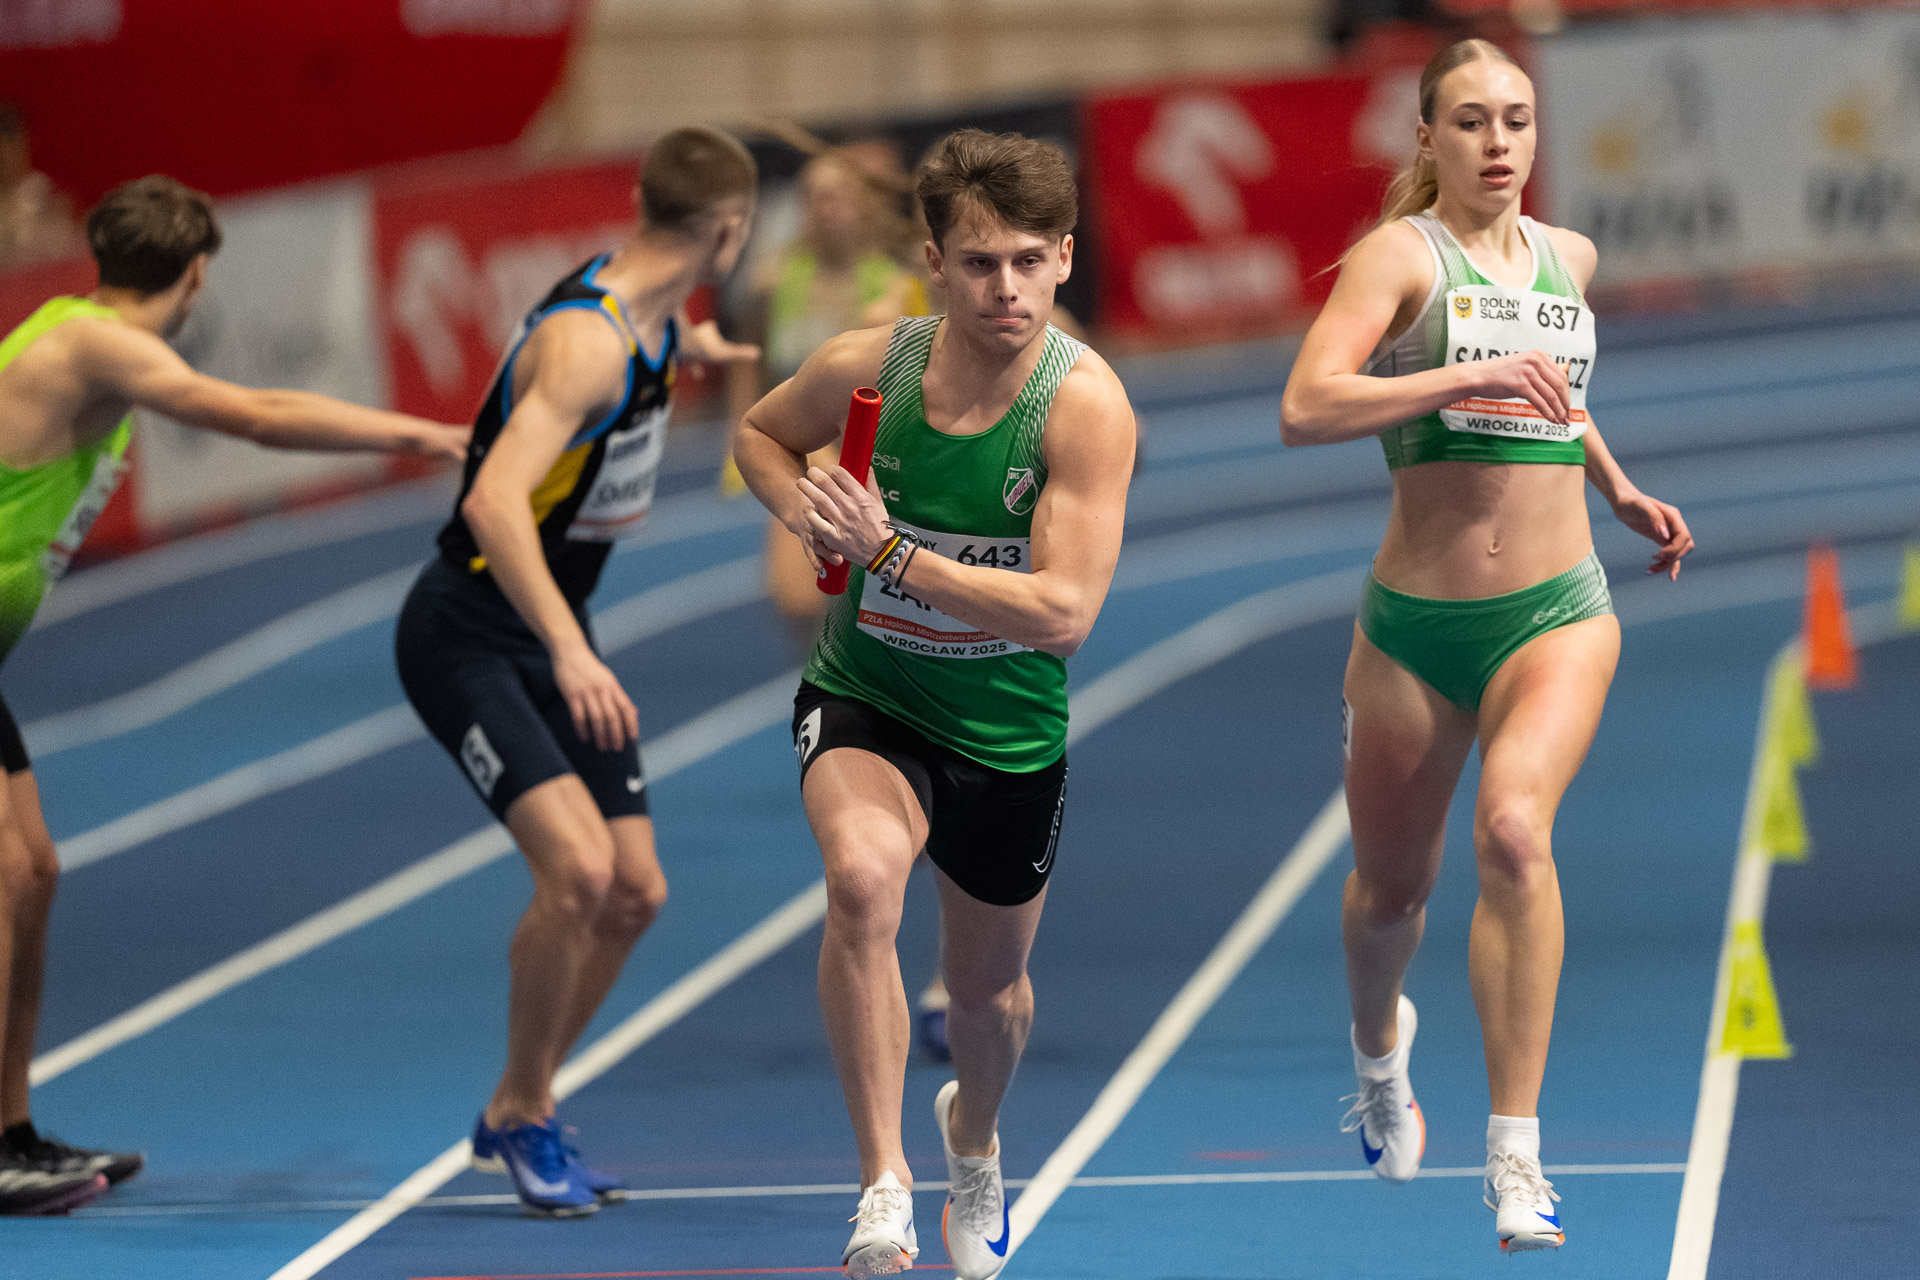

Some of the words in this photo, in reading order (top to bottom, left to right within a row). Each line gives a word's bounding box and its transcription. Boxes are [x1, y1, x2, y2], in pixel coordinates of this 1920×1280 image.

[1480, 297, 1521, 310] DOLNY
[1537, 302, 1580, 331] 637
[1466, 417, 1543, 435] WROCŁAW
[1545, 424, 1570, 437] 2025
[957, 544, 1022, 568] 643
[863, 613, 883, 625] PZLA
[884, 619, 916, 633] Halowe
[916, 627, 965, 641] Mistrzostwa
[882, 633, 966, 656] WROCŁAW
[970, 642, 1008, 656] 2025
